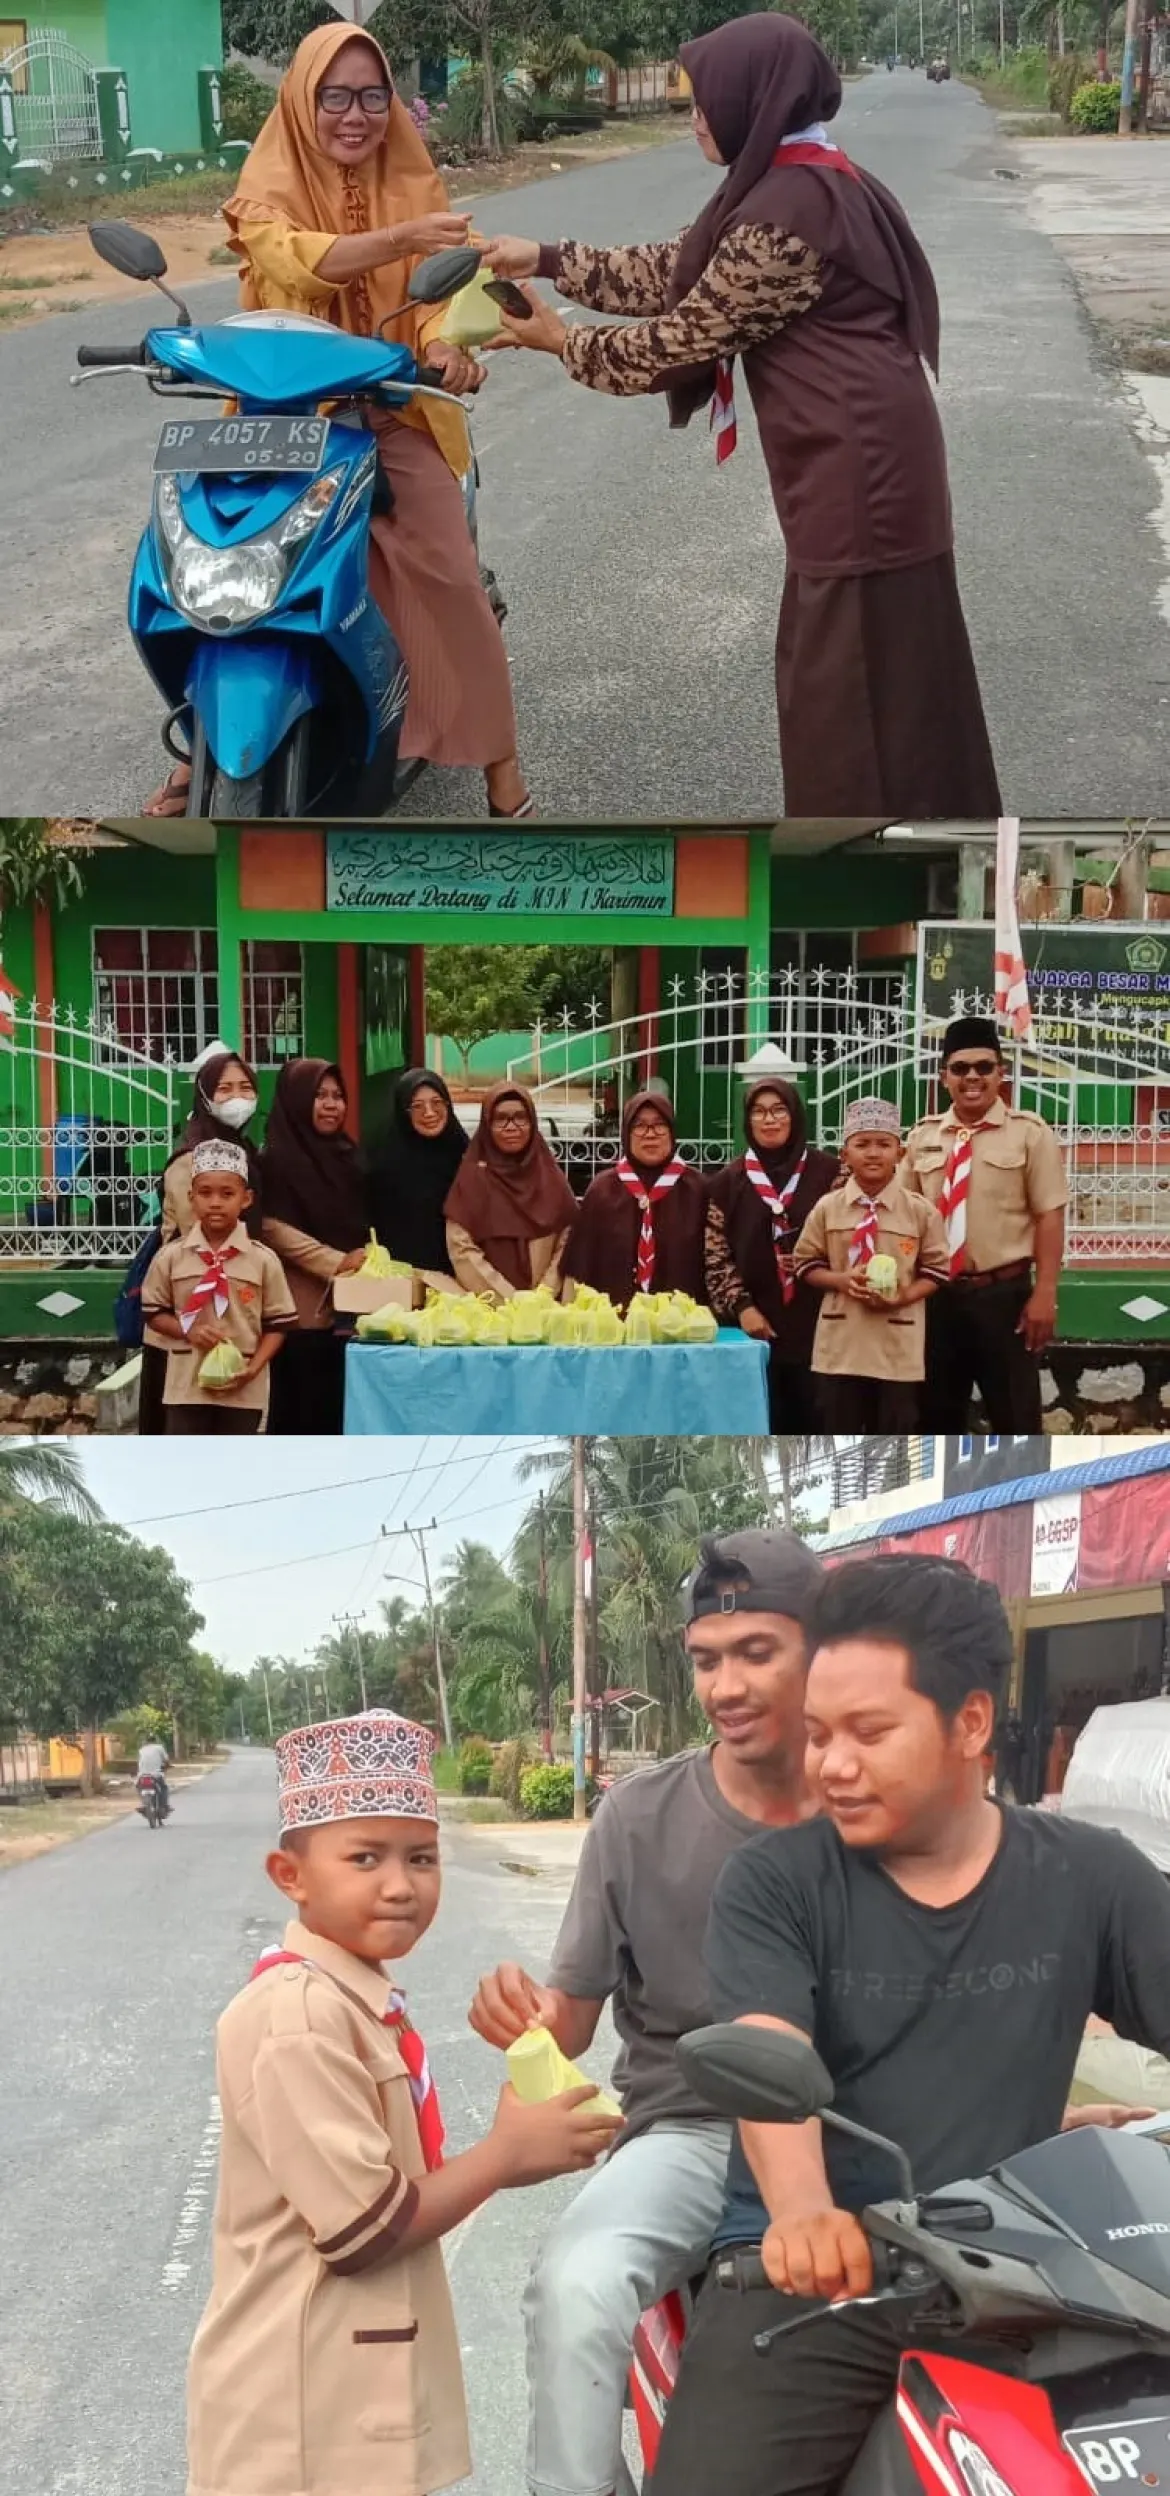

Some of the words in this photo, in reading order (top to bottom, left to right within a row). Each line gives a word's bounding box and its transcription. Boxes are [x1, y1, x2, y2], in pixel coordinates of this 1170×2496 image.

[162, 425, 195, 448] BP
[207, 421, 272, 446] 4057
[287, 422, 322, 444] KS
[335, 882, 417, 907] Selamat
[418, 883, 492, 911] Datang
[496, 886, 519, 909] di
[526, 885, 572, 910] MIN
[580, 886, 591, 909] 1
[591, 886, 667, 909] Karimun
[1097, 971, 1150, 991] BESAR
[1080, 2437, 1141, 2482] BP
